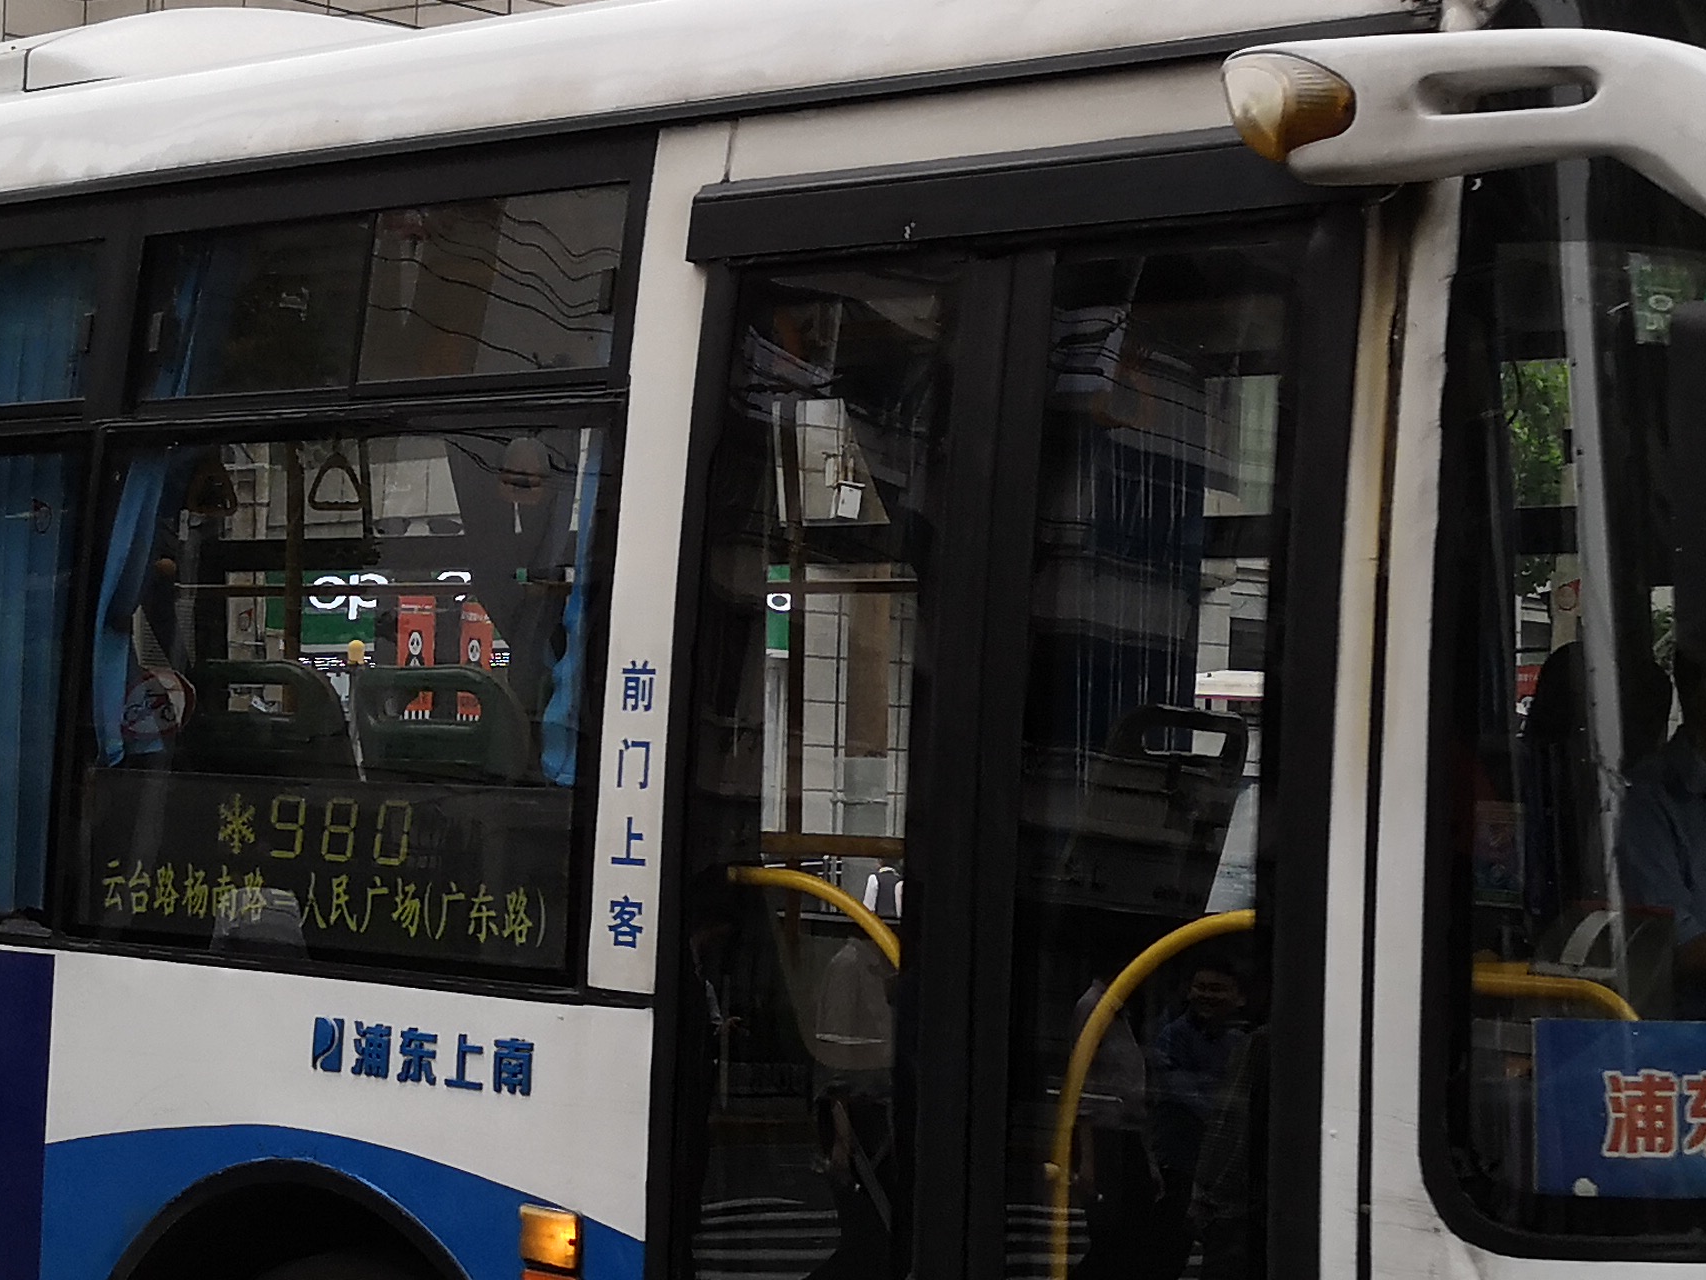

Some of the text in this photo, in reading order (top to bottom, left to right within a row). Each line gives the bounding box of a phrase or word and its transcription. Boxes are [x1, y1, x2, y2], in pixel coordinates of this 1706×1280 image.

[268, 794, 413, 866] 980
[607, 659, 658, 951] 前门上客
[350, 1020, 535, 1097] 浦东上南
